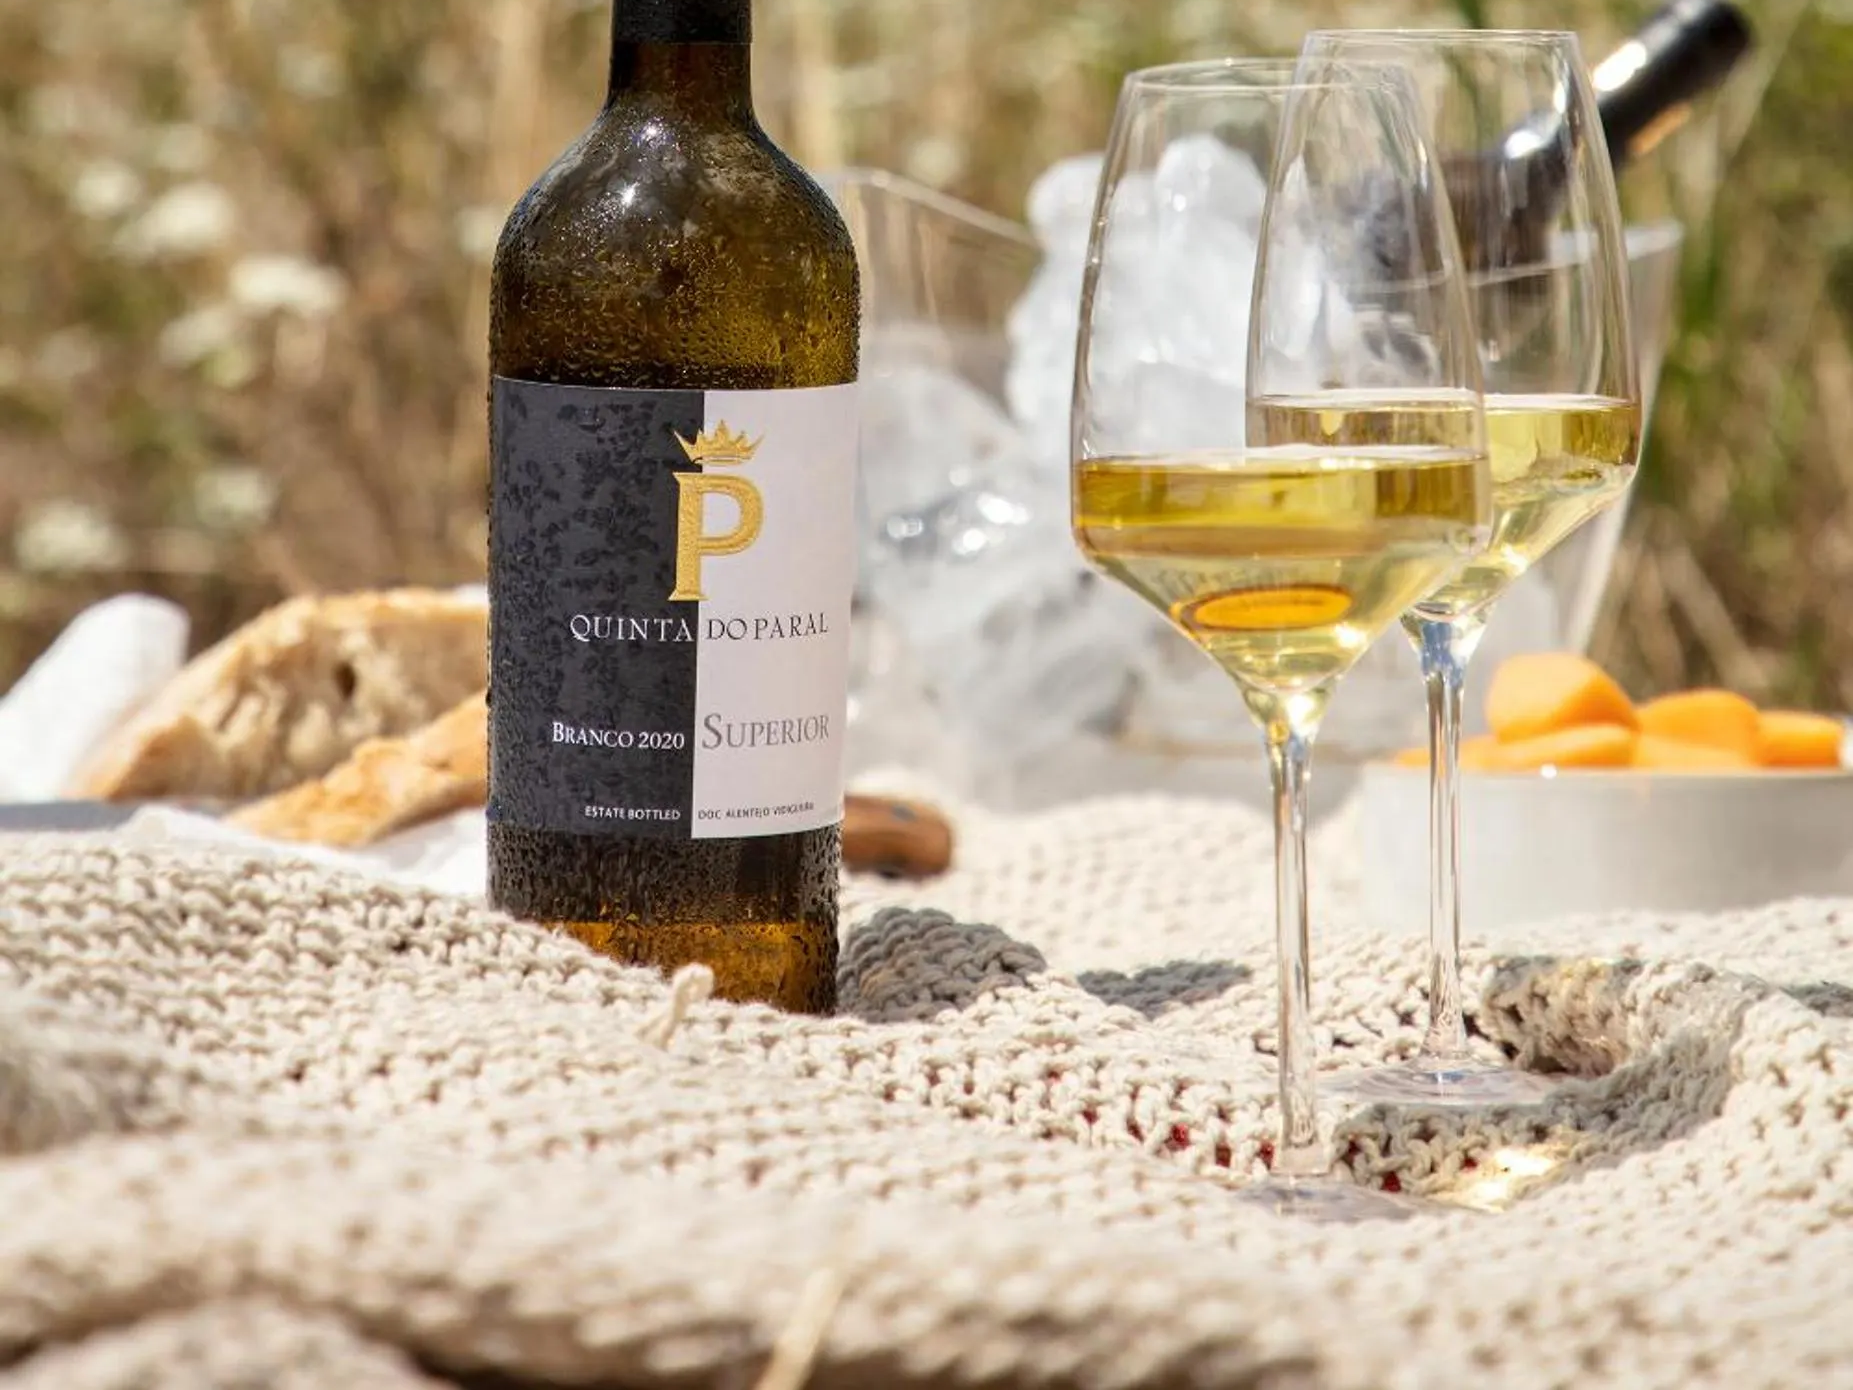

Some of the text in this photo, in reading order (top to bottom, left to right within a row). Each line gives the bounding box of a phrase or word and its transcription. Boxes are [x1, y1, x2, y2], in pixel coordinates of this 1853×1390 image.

[667, 472, 765, 602] P
[569, 612, 829, 643] QUINTA DO PARAL
[552, 721, 685, 750] BRANCO 2020
[702, 712, 829, 750] SUPERIOR
[584, 805, 681, 821] ESTATE BOTTLED
[698, 809, 721, 820] DOC
